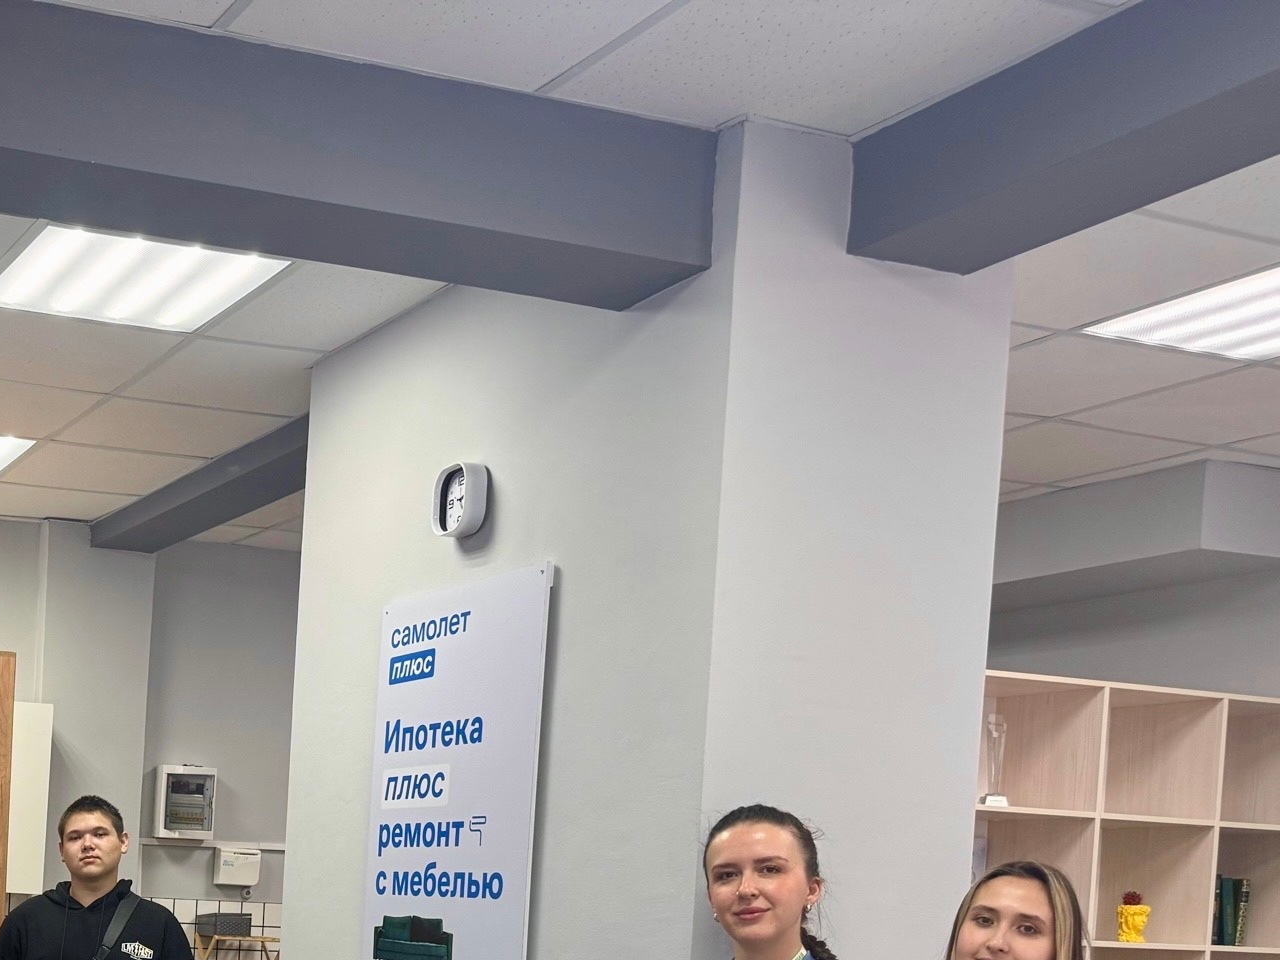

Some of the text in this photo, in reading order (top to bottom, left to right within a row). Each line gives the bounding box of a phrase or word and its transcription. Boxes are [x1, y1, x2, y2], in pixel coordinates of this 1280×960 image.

[390, 609, 471, 649] самолет
[391, 656, 433, 680] плюс
[383, 715, 484, 754] Ипотека
[384, 769, 445, 801] плюс
[378, 820, 465, 857] ремонт
[375, 861, 504, 900] с мебелью
